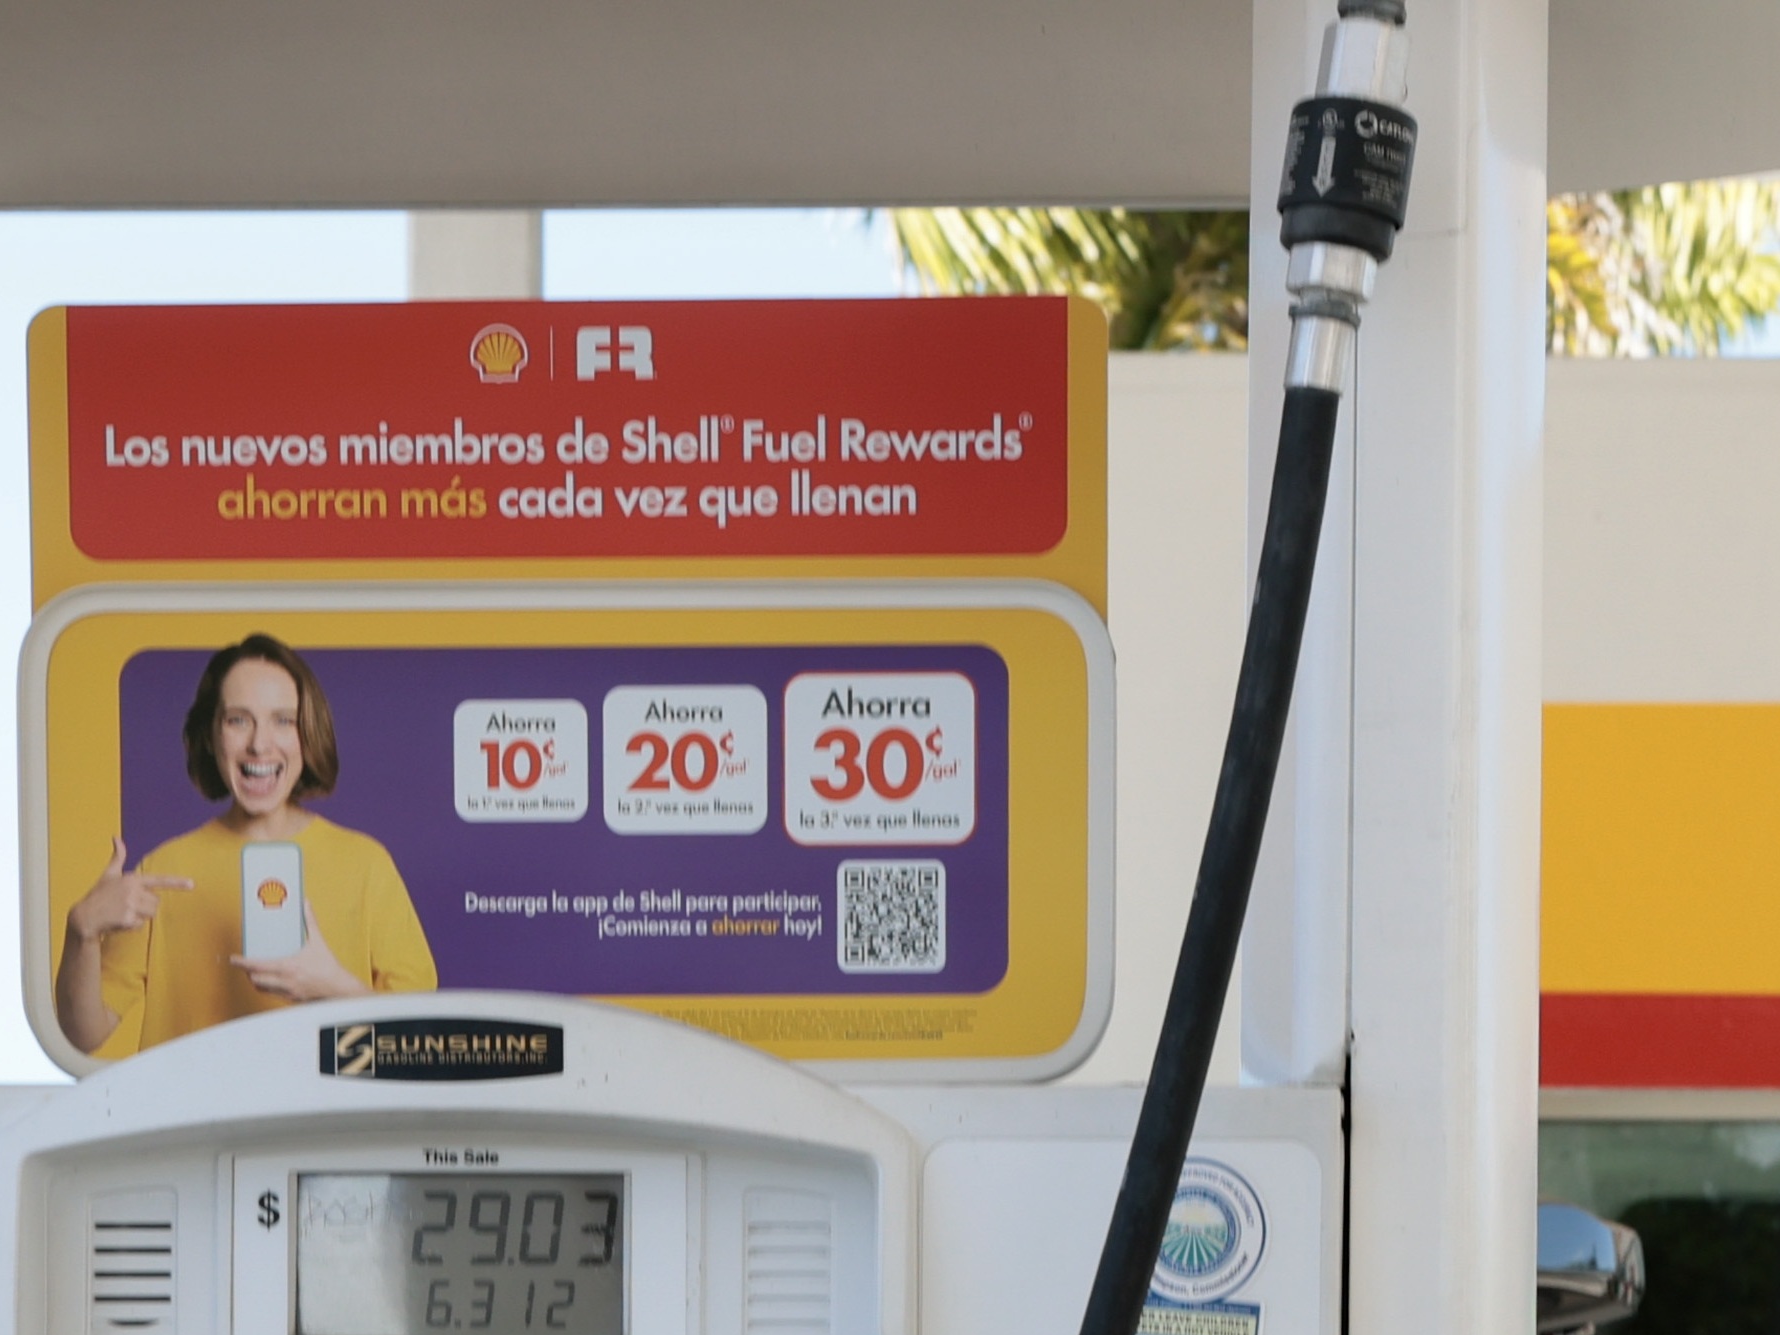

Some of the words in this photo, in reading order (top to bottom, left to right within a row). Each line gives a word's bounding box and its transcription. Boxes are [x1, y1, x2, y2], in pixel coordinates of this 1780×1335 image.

[105, 424, 170, 467] Los
[181, 434, 328, 467] nuevos
[339, 417, 545, 466] miembros
[556, 416, 610, 465] de
[742, 414, 826, 463] Fuel
[217, 468, 388, 521] ahorran
[401, 465, 488, 519] más
[498, 467, 603, 519] cada
[614, 480, 688, 519] vez
[698, 478, 779, 530] que
[790, 468, 917, 517] llenan
[644, 699, 723, 723] Ahorra
[821, 685, 931, 718] Ahorra
[485, 711, 556, 733] Ahorra
[464, 891, 548, 917] Descarga
[552, 890, 569, 913] la
[573, 894, 608, 917] app
[612, 890, 635, 912] de
[639, 890, 682, 913] Shell
[686, 895, 728, 917] para
[695, 920, 708, 936] a
[712, 914, 781, 936] ahorrar
[783, 914, 822, 941] hoy!
[376, 1034, 548, 1053] SUNSHINE
[424, 1148, 458, 1165] This
[464, 1149, 499, 1165] Sale
[257, 1189, 281, 1229] $
